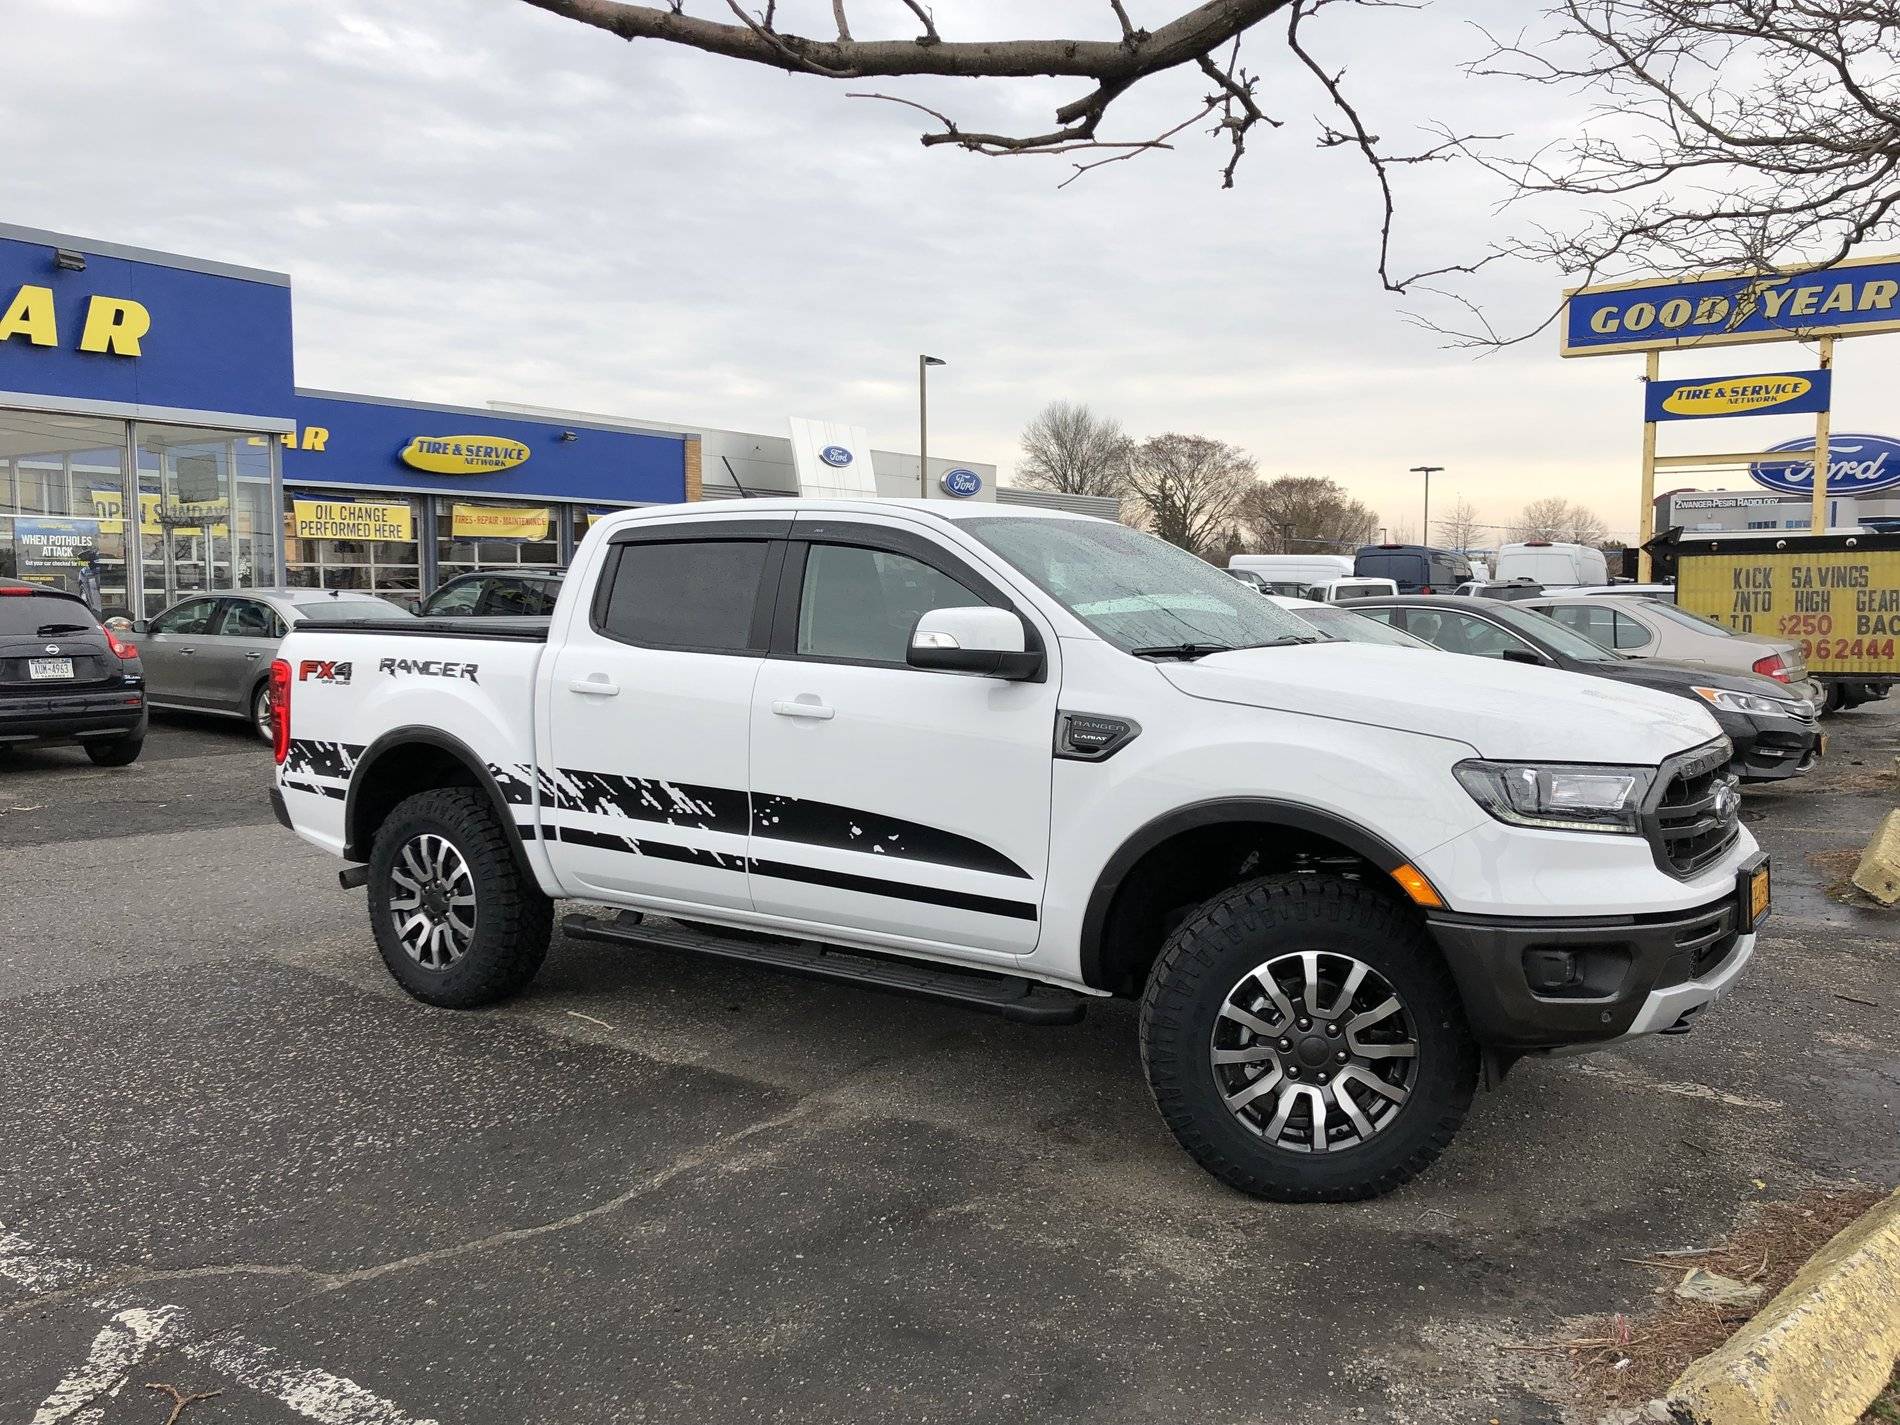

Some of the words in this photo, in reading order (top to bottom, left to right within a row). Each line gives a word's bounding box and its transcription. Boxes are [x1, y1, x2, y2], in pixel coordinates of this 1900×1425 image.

[0, 284, 151, 357] AR
[1676, 389, 1713, 401] TIRE
[1714, 388, 1727, 398] &
[1729, 382, 1803, 398] SERVICE
[1727, 395, 1778, 405] NETWORK
[418, 440, 450, 455] TIRE
[452, 444, 463, 456] &
[465, 444, 525, 461] SERVICE
[829, 448, 848, 463] Ford
[463, 457, 507, 467] NETWORK
[953, 473, 976, 491] Ford
[315, 504, 336, 521] OIL
[339, 505, 388, 523] CHANGE
[454, 514, 473, 525] TIRES
[476, 515, 499, 525] REPAIR
[502, 516, 547, 526] MAINTENANCE
[300, 520, 371, 538] PERFORMED
[373, 523, 403, 539] HERE
[21, 534, 48, 546] WHEN
[48, 535, 93, 547] POTHOLES
[42, 546, 74, 557] ATTACK
[1733, 567, 1775, 590] KICK
[1791, 565, 1870, 589] SAVINGS
[1794, 591, 1831, 613] HIGH
[1856, 589, 1900, 613] GEAR
[1779, 614, 1833, 636] $250
[299, 660, 352, 681] FX4
[379, 657, 480, 687] RANGER
[1073, 720, 1124, 731] RANGER
